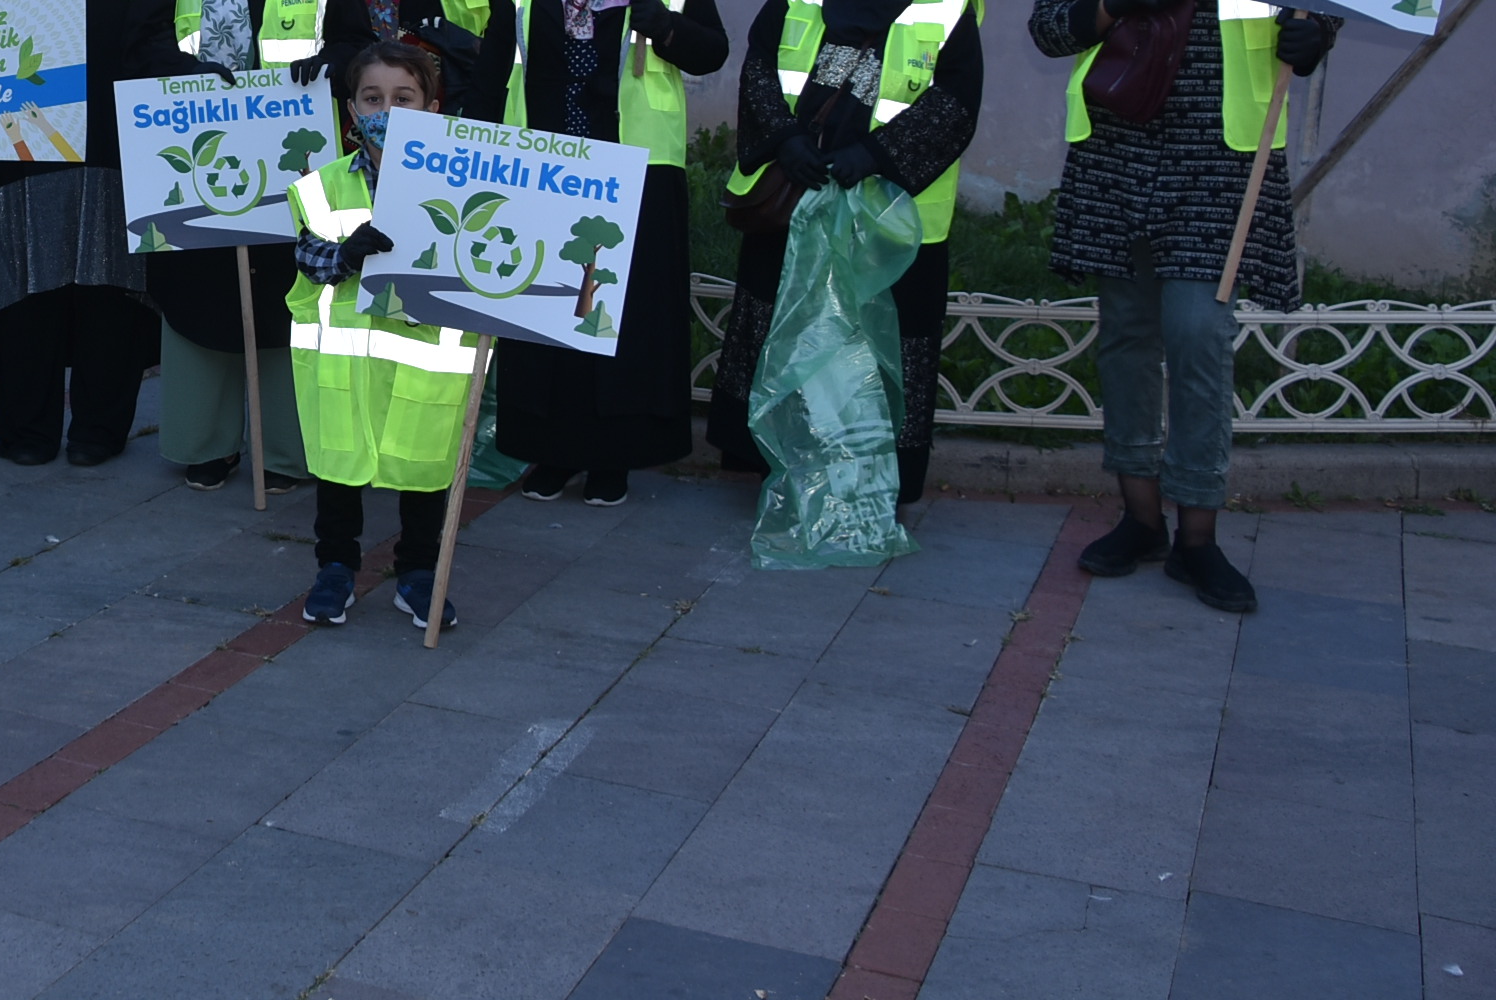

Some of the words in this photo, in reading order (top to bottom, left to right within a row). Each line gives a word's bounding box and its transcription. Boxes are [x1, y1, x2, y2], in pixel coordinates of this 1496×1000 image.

[157, 75, 216, 95] Temiz
[133, 96, 239, 134] Sağlıklı
[245, 93, 315, 120] Kent
[442, 115, 511, 147] Temiz
[516, 128, 592, 161] Sokak
[401, 140, 530, 188] Sağlıklı
[537, 161, 621, 204] Kent
